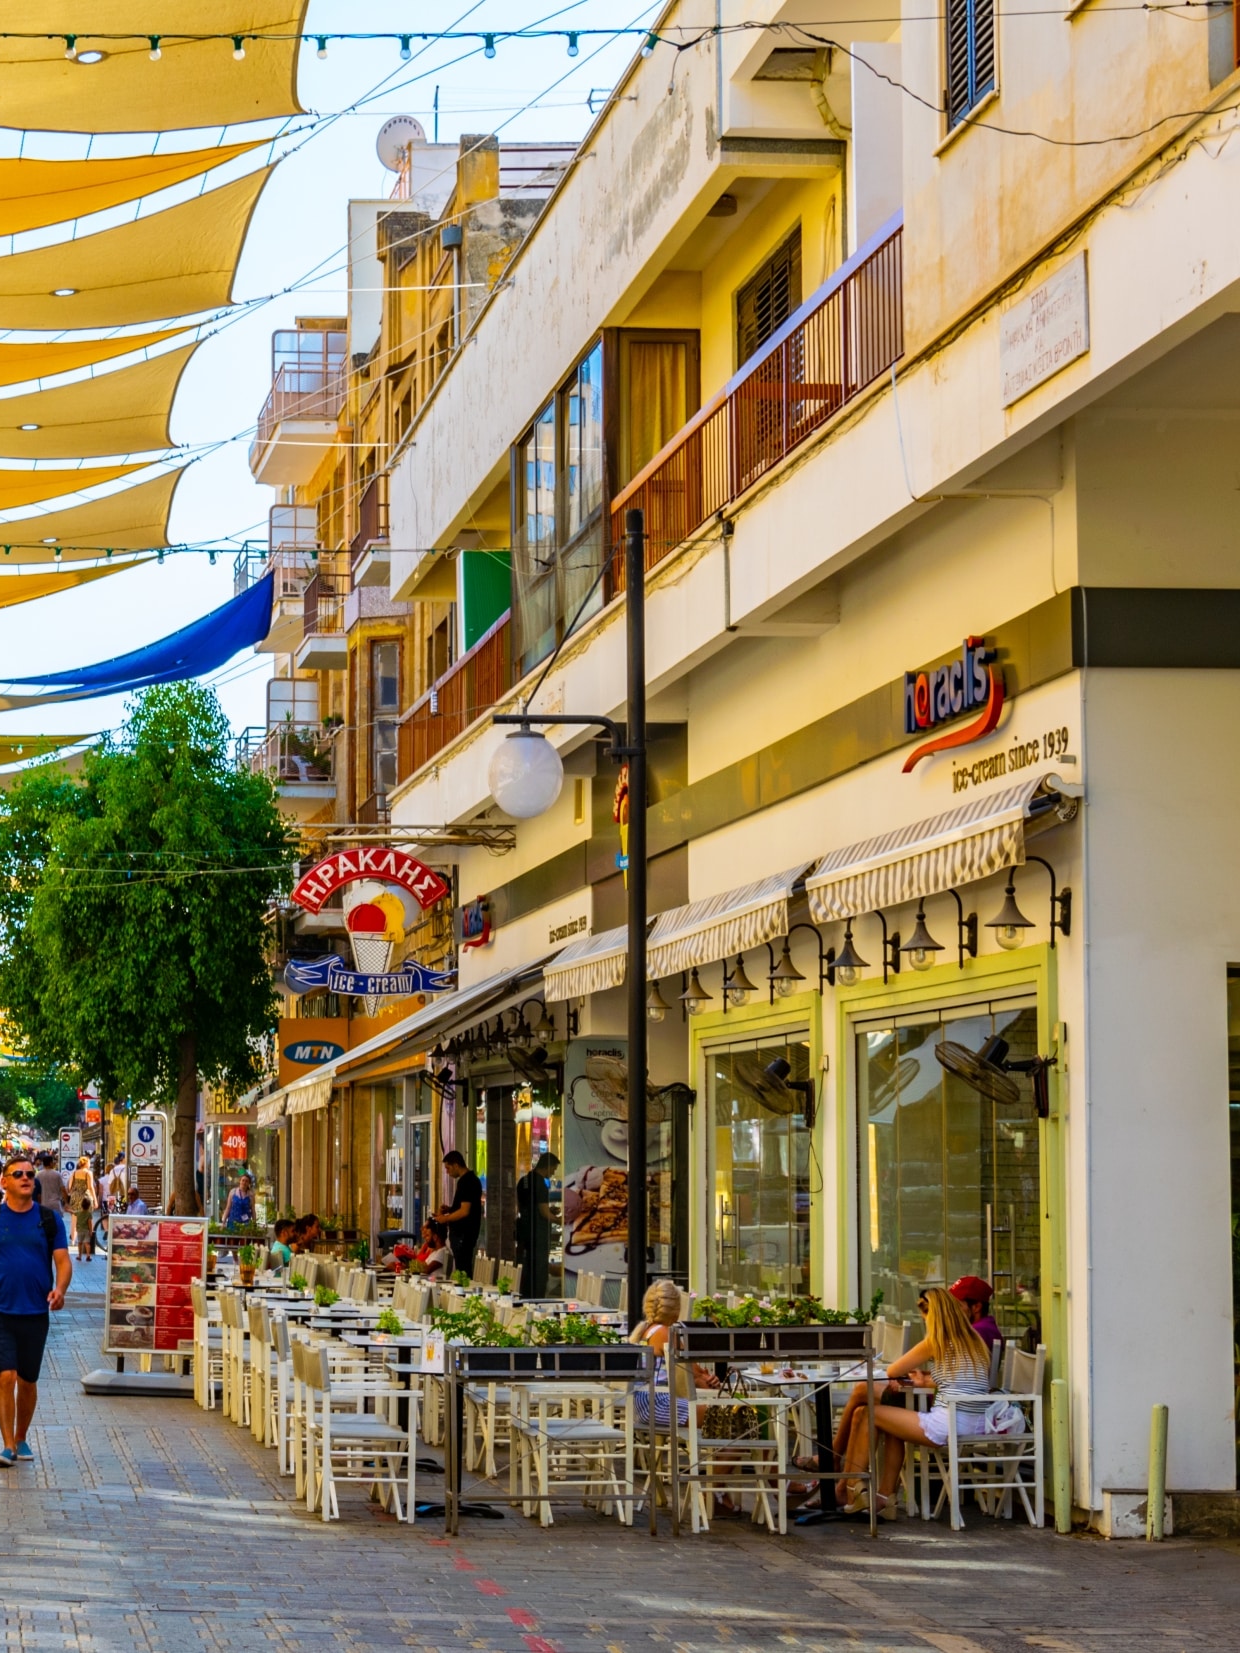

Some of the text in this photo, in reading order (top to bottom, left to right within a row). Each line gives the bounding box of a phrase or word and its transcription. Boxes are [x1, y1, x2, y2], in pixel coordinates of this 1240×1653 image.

[952, 727, 1069, 793] ice-cream since 1939
[301, 848, 437, 904] ΗΡΑΚΛΗΣ
[294, 1045, 335, 1060] MTN
[586, 1047, 624, 1058] horaclis
[223, 1135, 247, 1149] -40%
